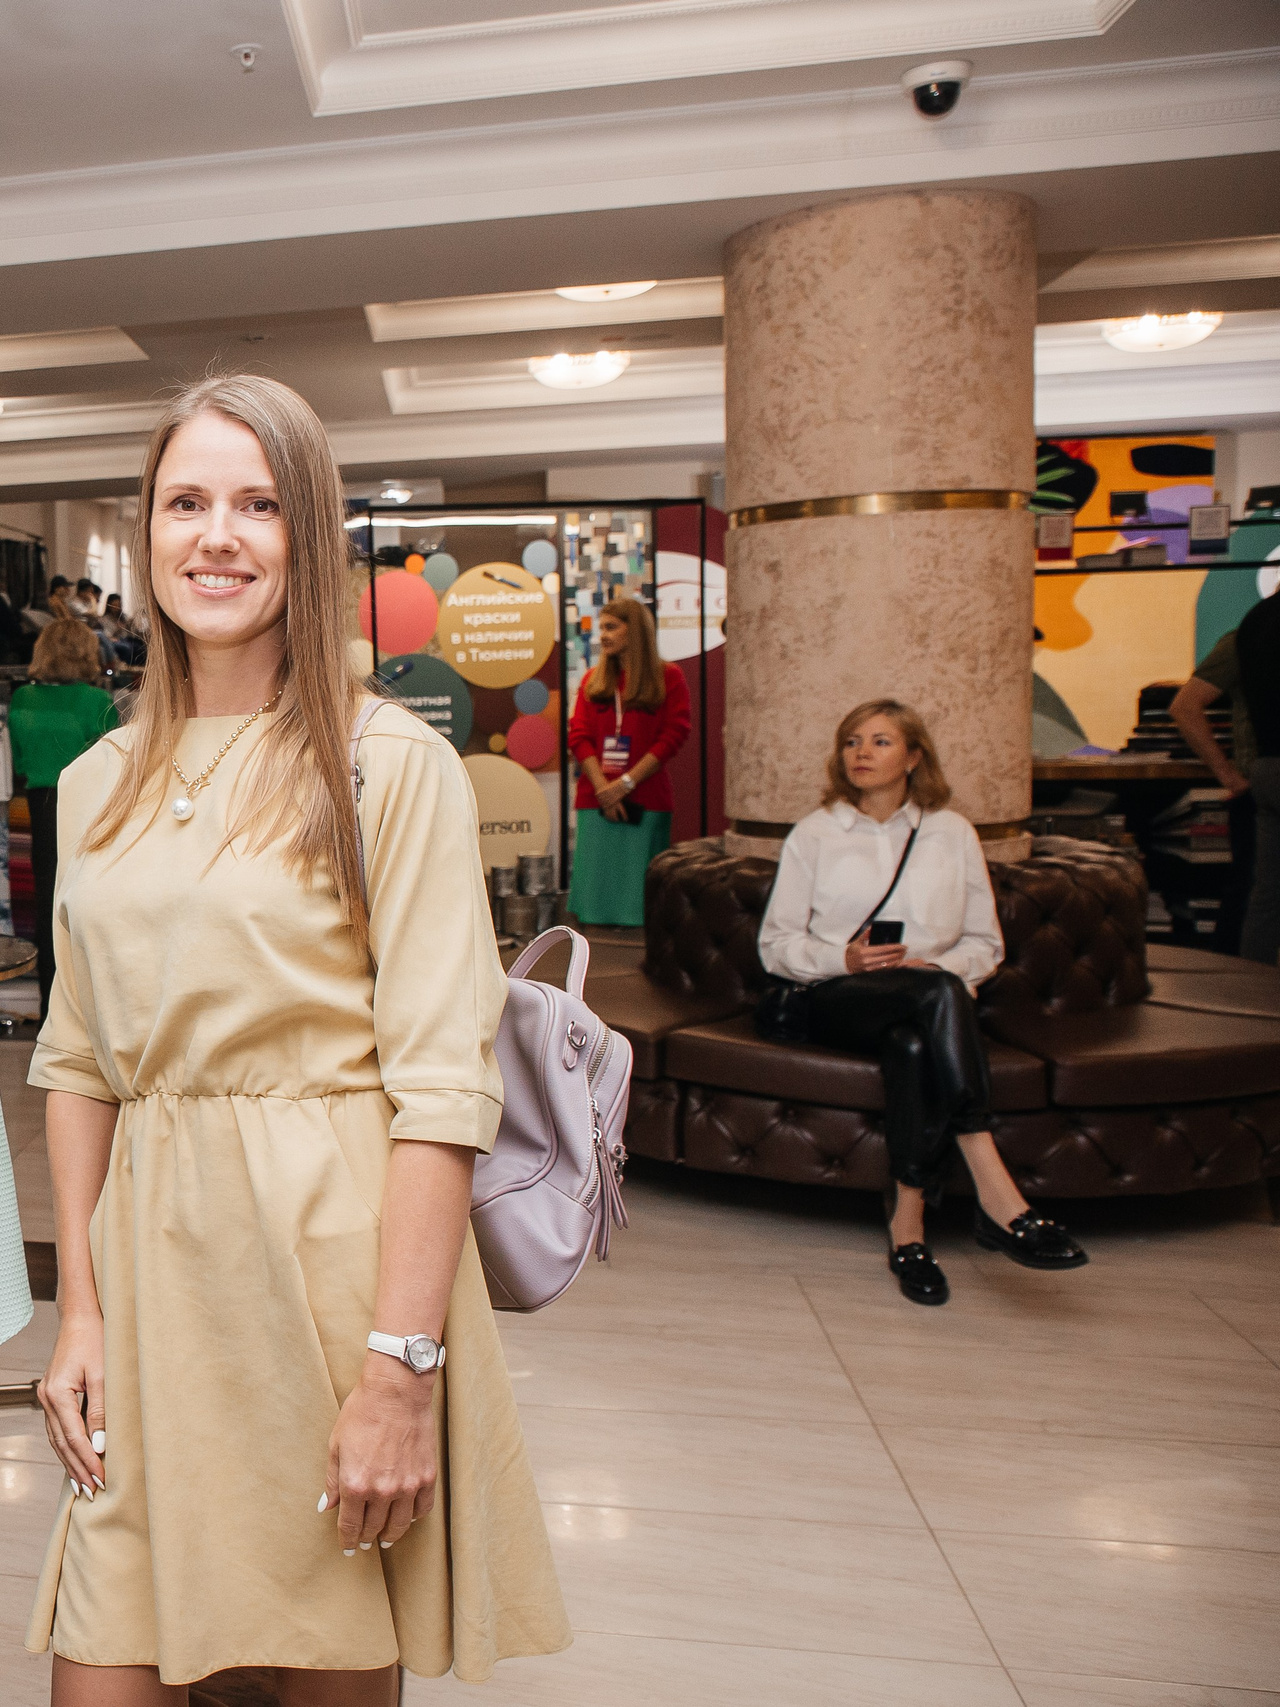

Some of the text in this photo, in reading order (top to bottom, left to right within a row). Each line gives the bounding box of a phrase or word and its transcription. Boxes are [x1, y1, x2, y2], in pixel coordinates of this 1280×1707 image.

[447, 591, 544, 607] Английские
[463, 612, 521, 627] краски
[451, 630, 534, 644] в наличии
[456, 647, 534, 663] в Тюмени
[400, 695, 451, 707] платная
[480, 820, 531, 835] erson
